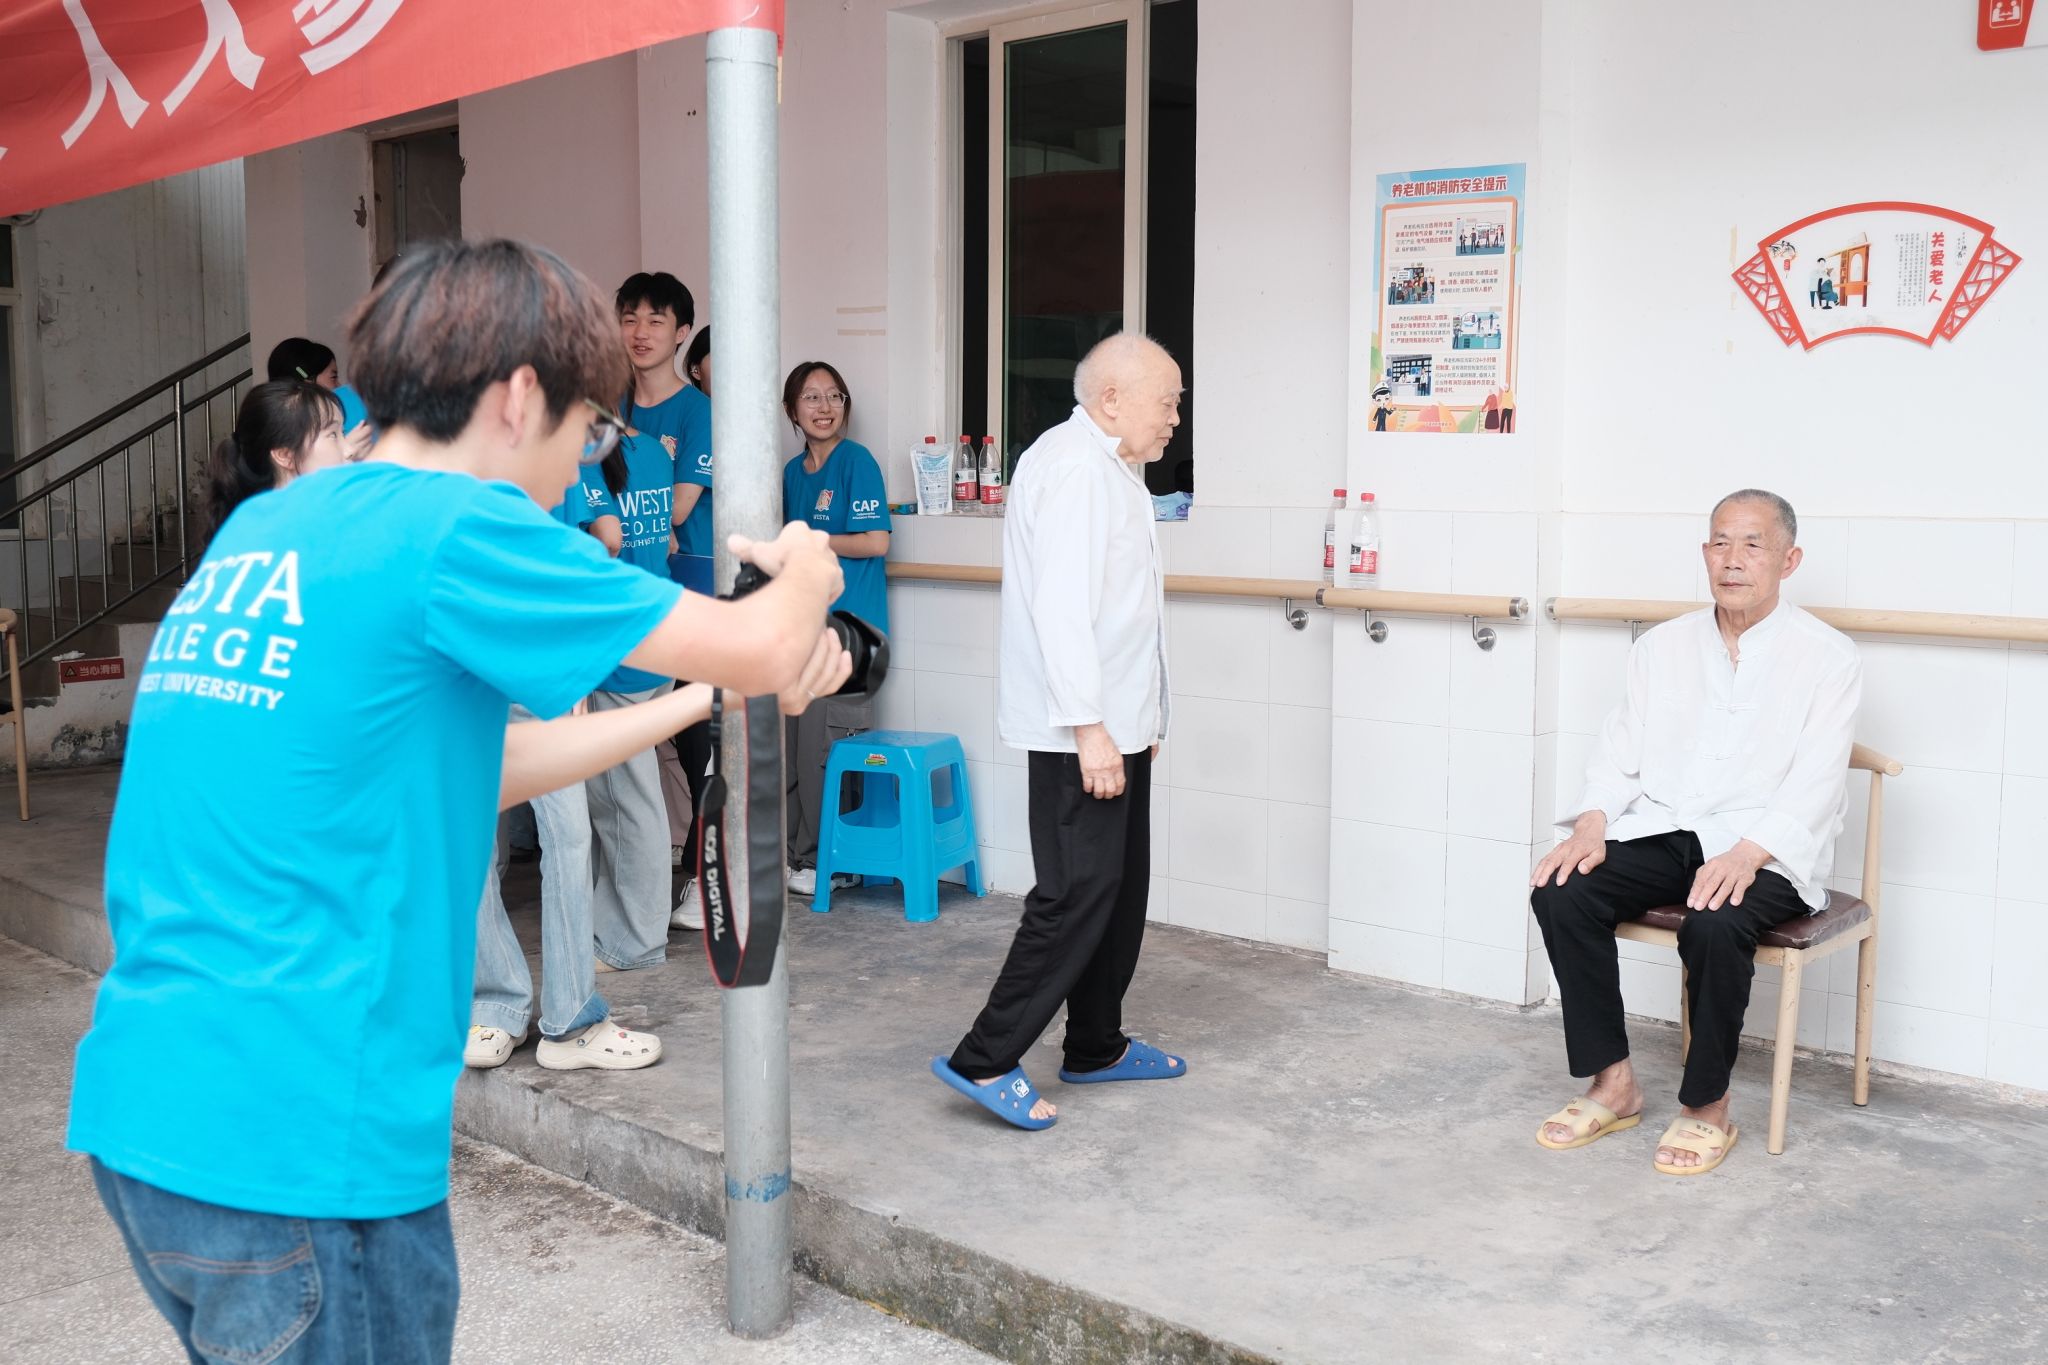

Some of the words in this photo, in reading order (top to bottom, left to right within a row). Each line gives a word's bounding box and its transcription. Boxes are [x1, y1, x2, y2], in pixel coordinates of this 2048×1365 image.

[1391, 177, 1508, 198] 养老机构消防安全提示
[1928, 231, 1945, 303] 关爱老人
[616, 486, 674, 518] WEST
[852, 499, 880, 513] CAP
[80, 664, 121, 676] 当心滑倒
[707, 867, 726, 941] DIGITAL
